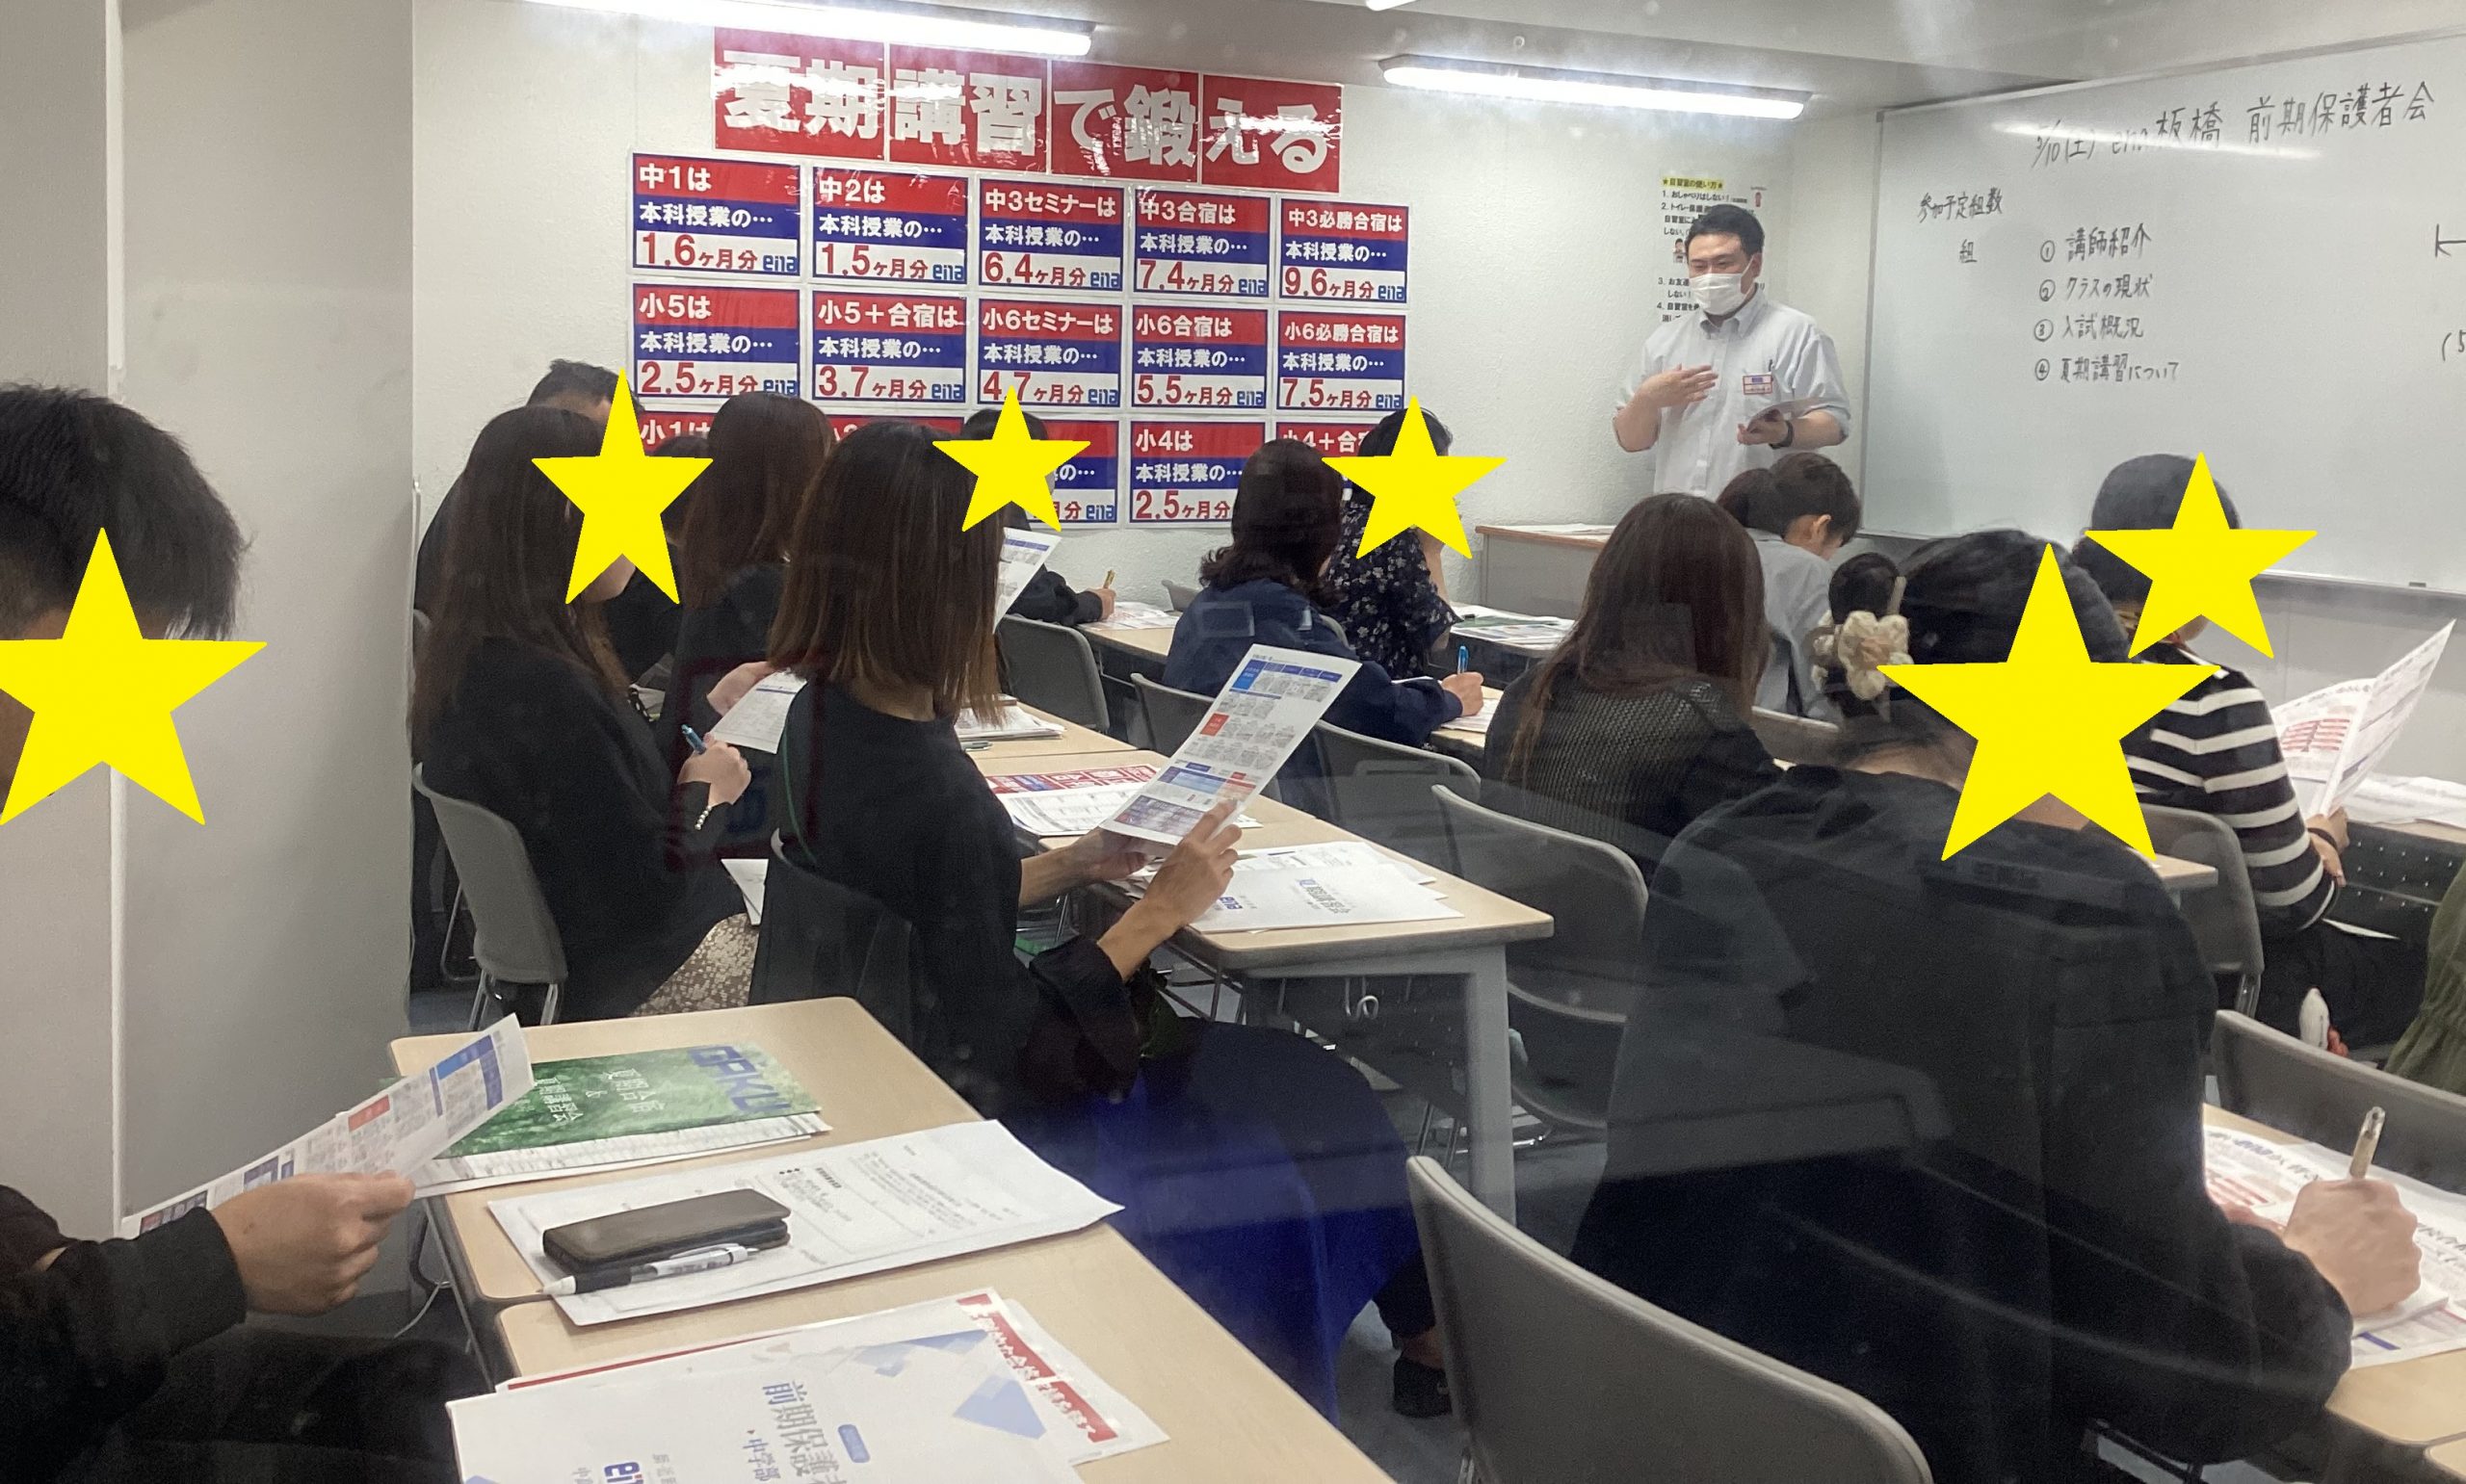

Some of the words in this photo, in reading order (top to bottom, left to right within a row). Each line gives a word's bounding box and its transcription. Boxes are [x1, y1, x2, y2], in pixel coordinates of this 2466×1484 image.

[721, 50, 1328, 174] 夏期講習で鍛える
[2247, 81, 2434, 143] 前期保護者会
[639, 163, 712, 192] 中1は
[819, 175, 885, 204] 中2は
[985, 189, 1115, 218] 中3セミナーは
[1141, 200, 1236, 225] 中3合宿は
[1918, 187, 2004, 222] 参加予定組数
[1288, 208, 1403, 232] 中3必勝合宿は
[642, 233, 758, 271] 1.6ヶ月分
[762, 254, 799, 273] ena
[1959, 239, 1978, 263] 組
[2065, 222, 2152, 262] 講師紹介
[822, 243, 929, 279] 1.5ヶ月分
[932, 263, 963, 281] ena
[984, 251, 1086, 287] 6.4ヶ月分
[1090, 271, 1120, 288] ena
[1140, 259, 1234, 293] 7.4ヶ月分
[1238, 277, 1267, 295] ena
[1285, 267, 1374, 299] 9.6ヶ月分
[1377, 283, 1405, 300] ena
[2066, 273, 2153, 299] クラスの現状
[640, 293, 712, 320] 小5は
[983, 307, 1114, 334] 小6セミナーは
[1137, 314, 1232, 338] 小6合宿は
[1285, 322, 1399, 344] 小6必勝合宿は
[2061, 313, 2144, 339] 入試概況
[641, 361, 757, 395] 2.5ヶ月分
[763, 378, 798, 394] ena
[2060, 353, 2180, 382] 夏期講習について
[820, 365, 928, 399] 3.7ヶ月分
[931, 380, 963, 401] ena
[1088, 388, 1118, 404] ena
[1138, 375, 1233, 405] 5.5ヶ月分
[1237, 389, 1266, 406] ena
[1283, 378, 1372, 408] 7.5ヶ月分
[1376, 392, 1404, 409] ena
[1136, 430, 1193, 452] 小4は
[1086, 504, 1115, 520] ena
[1136, 490, 1230, 521] 2.5ヶ月分
